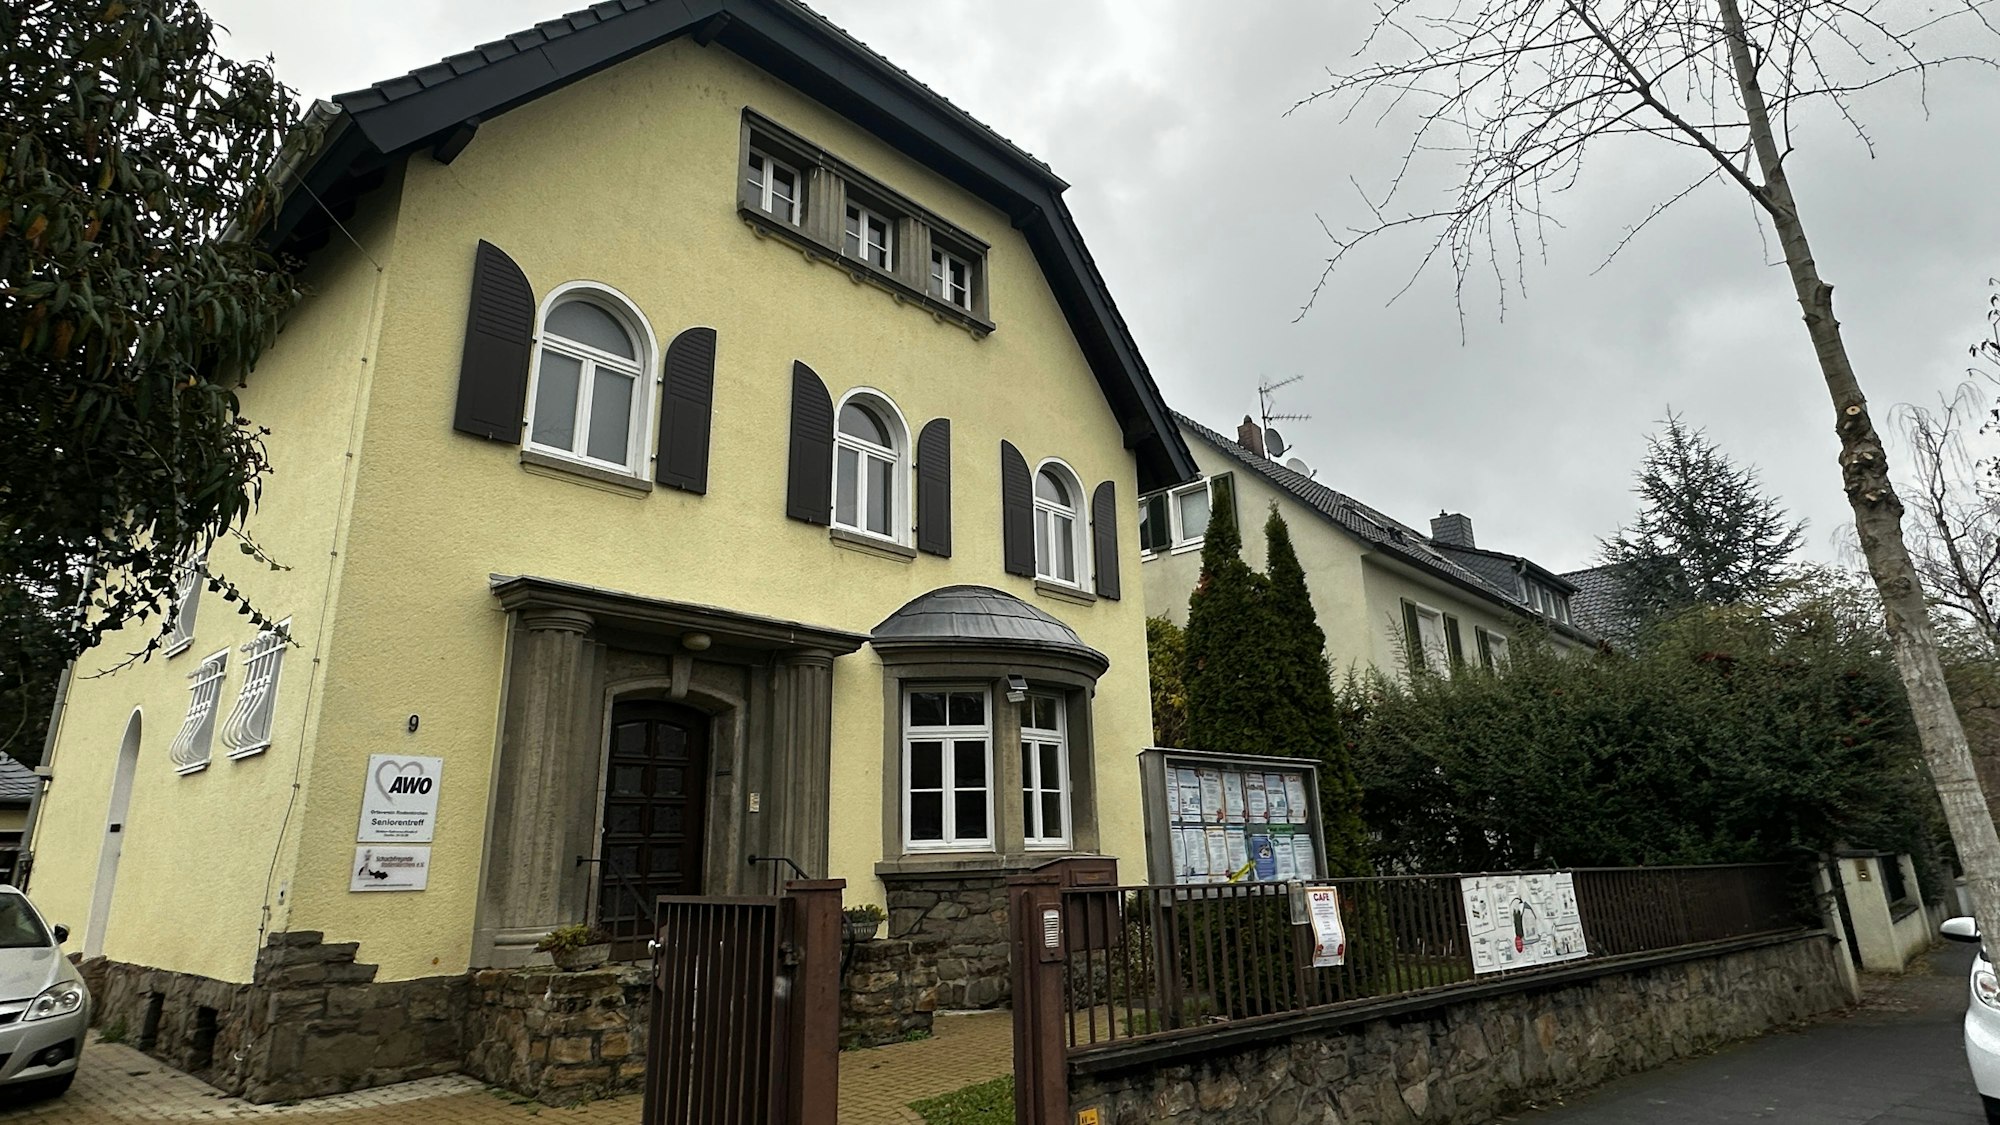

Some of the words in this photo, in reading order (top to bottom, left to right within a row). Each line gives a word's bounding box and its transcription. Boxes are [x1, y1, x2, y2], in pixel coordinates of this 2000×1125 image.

[408, 714, 419, 733] 9
[388, 776, 433, 795] AWO
[371, 818, 425, 826] Seniorentreff
